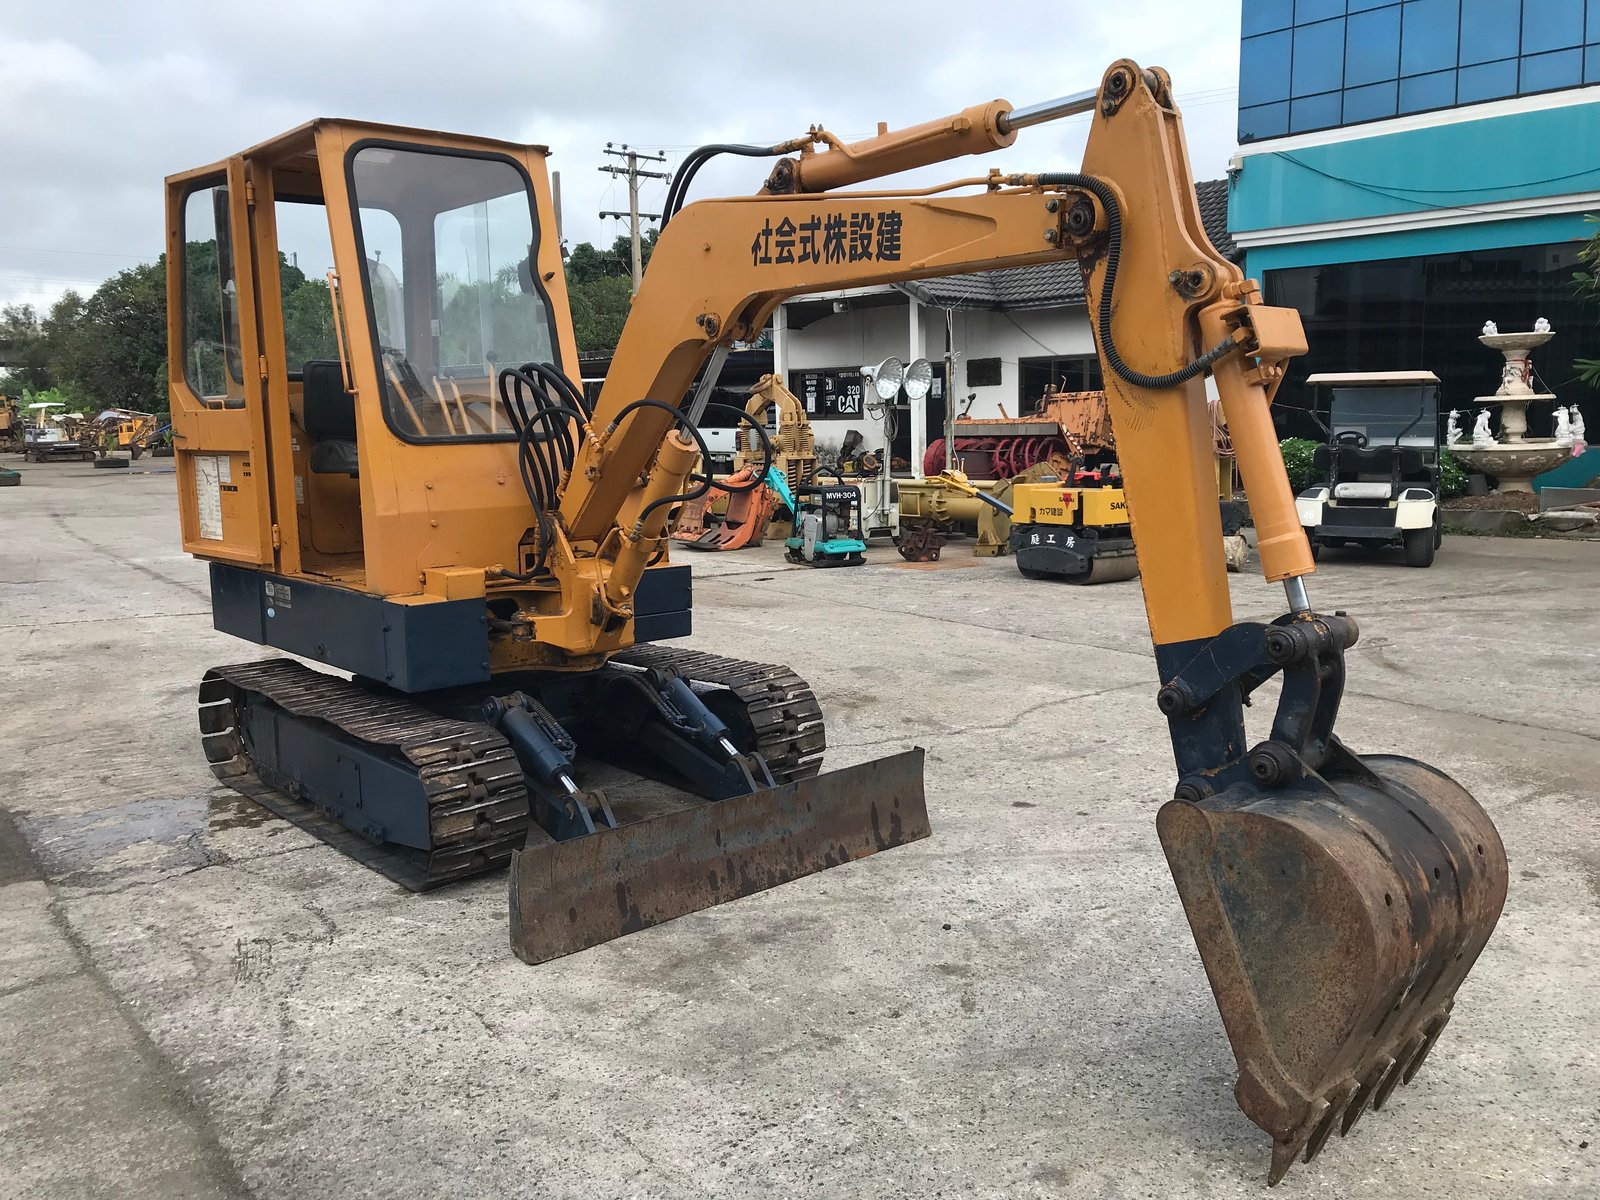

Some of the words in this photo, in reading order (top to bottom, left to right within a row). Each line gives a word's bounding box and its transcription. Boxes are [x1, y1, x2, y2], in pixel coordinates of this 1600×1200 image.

[847, 385, 860, 395] 320
[838, 395, 860, 413] CAT
[826, 491, 857, 500] MVH-304
[1110, 501, 1128, 510] SAK
